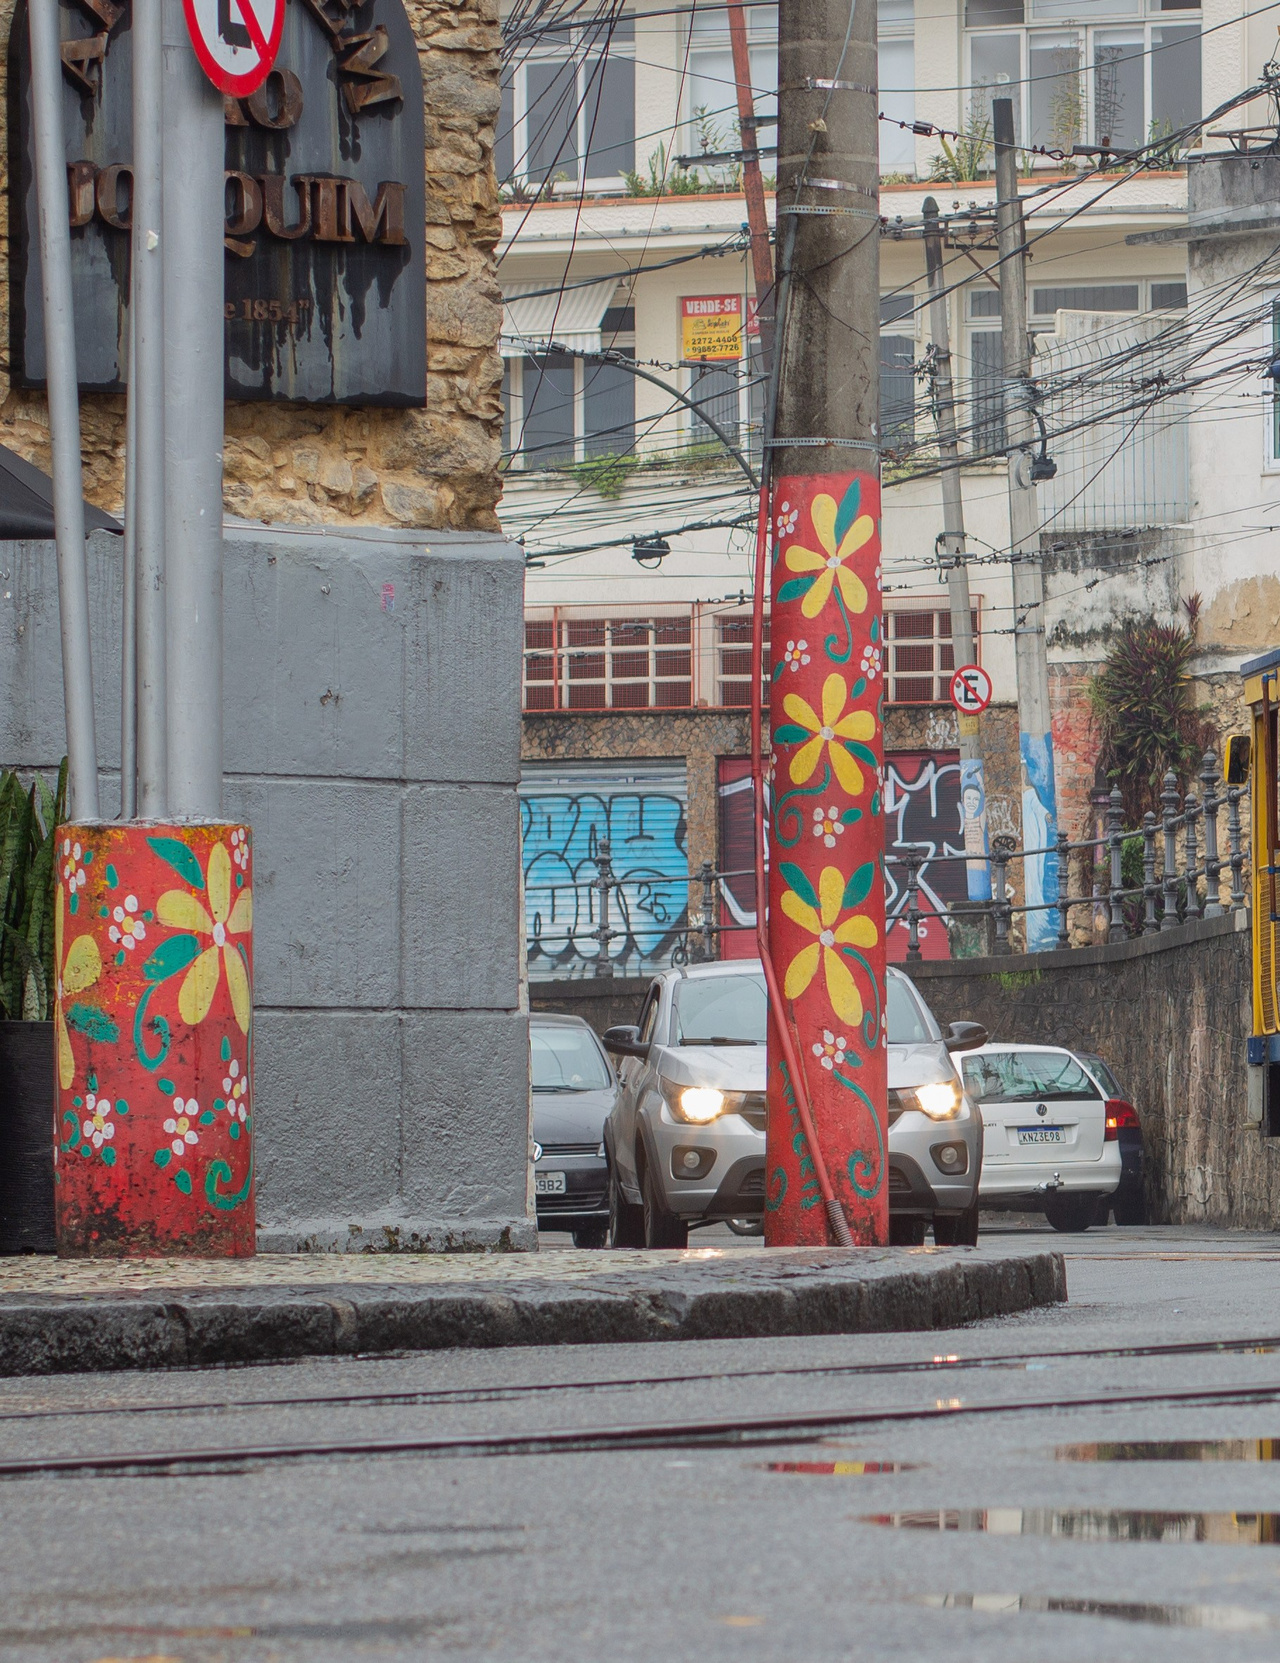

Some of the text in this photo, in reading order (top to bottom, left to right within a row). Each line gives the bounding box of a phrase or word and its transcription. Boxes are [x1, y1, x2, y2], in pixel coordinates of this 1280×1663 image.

[66, 160, 408, 258] JOQUIM
[686, 298, 737, 314] VENDE-SE
[691, 336, 738, 345] 2272-4400
[1022, 1131, 1060, 1142] KNZ3E98
